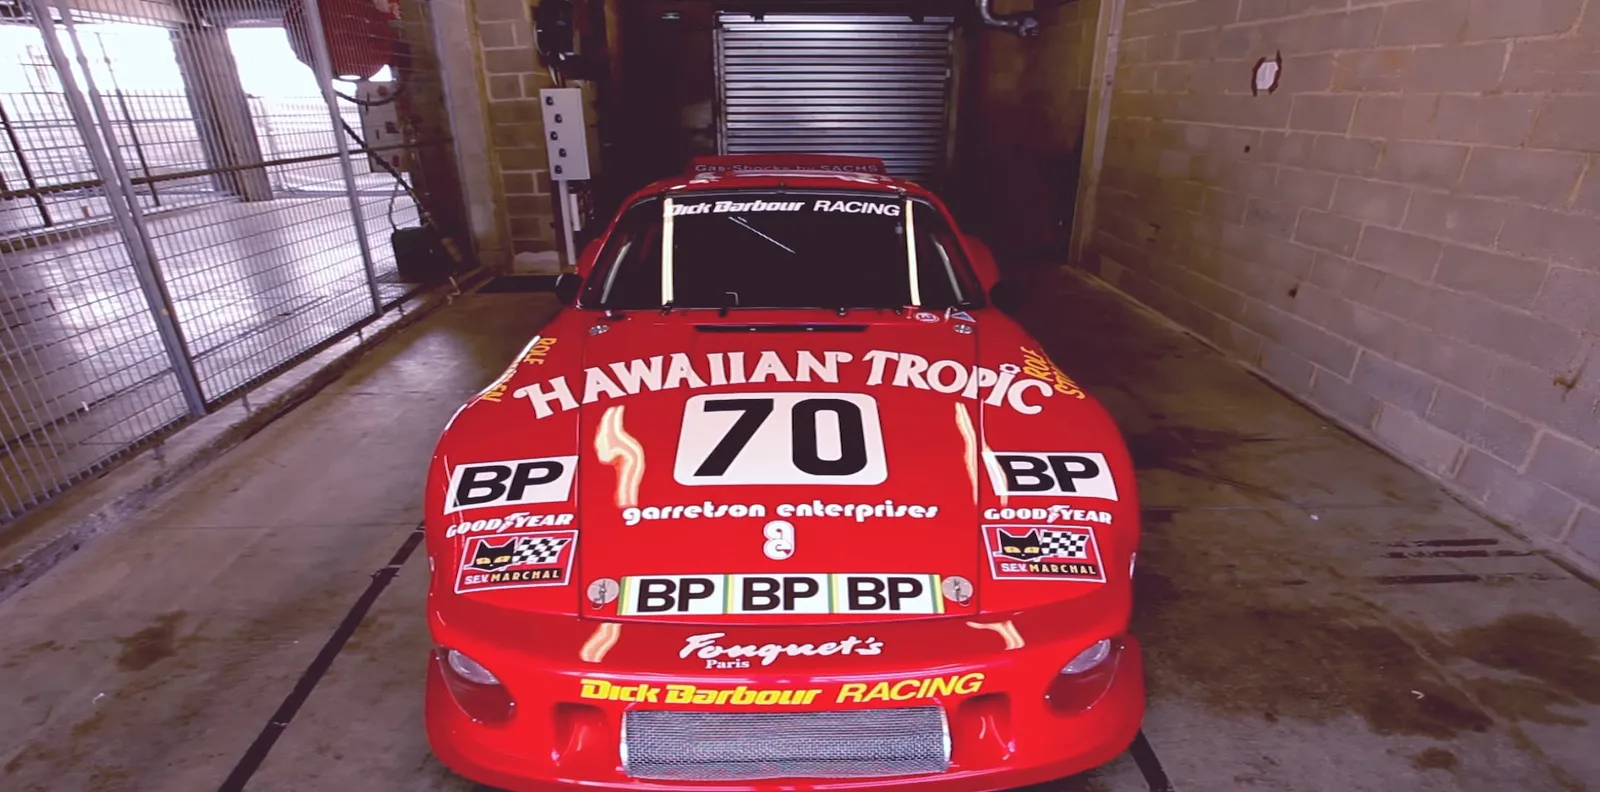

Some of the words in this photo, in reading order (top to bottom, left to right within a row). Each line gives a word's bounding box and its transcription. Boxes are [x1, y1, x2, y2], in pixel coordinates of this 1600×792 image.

[663, 202, 712, 217] Dick
[713, 200, 806, 213] Barbour
[813, 200, 900, 216] RACING
[512, 350, 853, 419] HAWAIIAN
[861, 349, 1054, 415] TROPIC
[693, 398, 868, 478] 70
[452, 460, 564, 508] BP
[994, 455, 1100, 493] BP
[622, 501, 766, 526] garretson
[776, 499, 938, 522] enterprises
[490, 570, 561, 583] MARCHAL
[1029, 563, 1097, 575] MARCHAL
[636, 577, 716, 613] BP
[741, 576, 820, 611] BP
[847, 576, 924, 611] BP
[705, 658, 750, 669] Paris
[580, 678, 661, 703] Dick
[664, 684, 823, 706] Barbour
[836, 672, 985, 704] RACING
